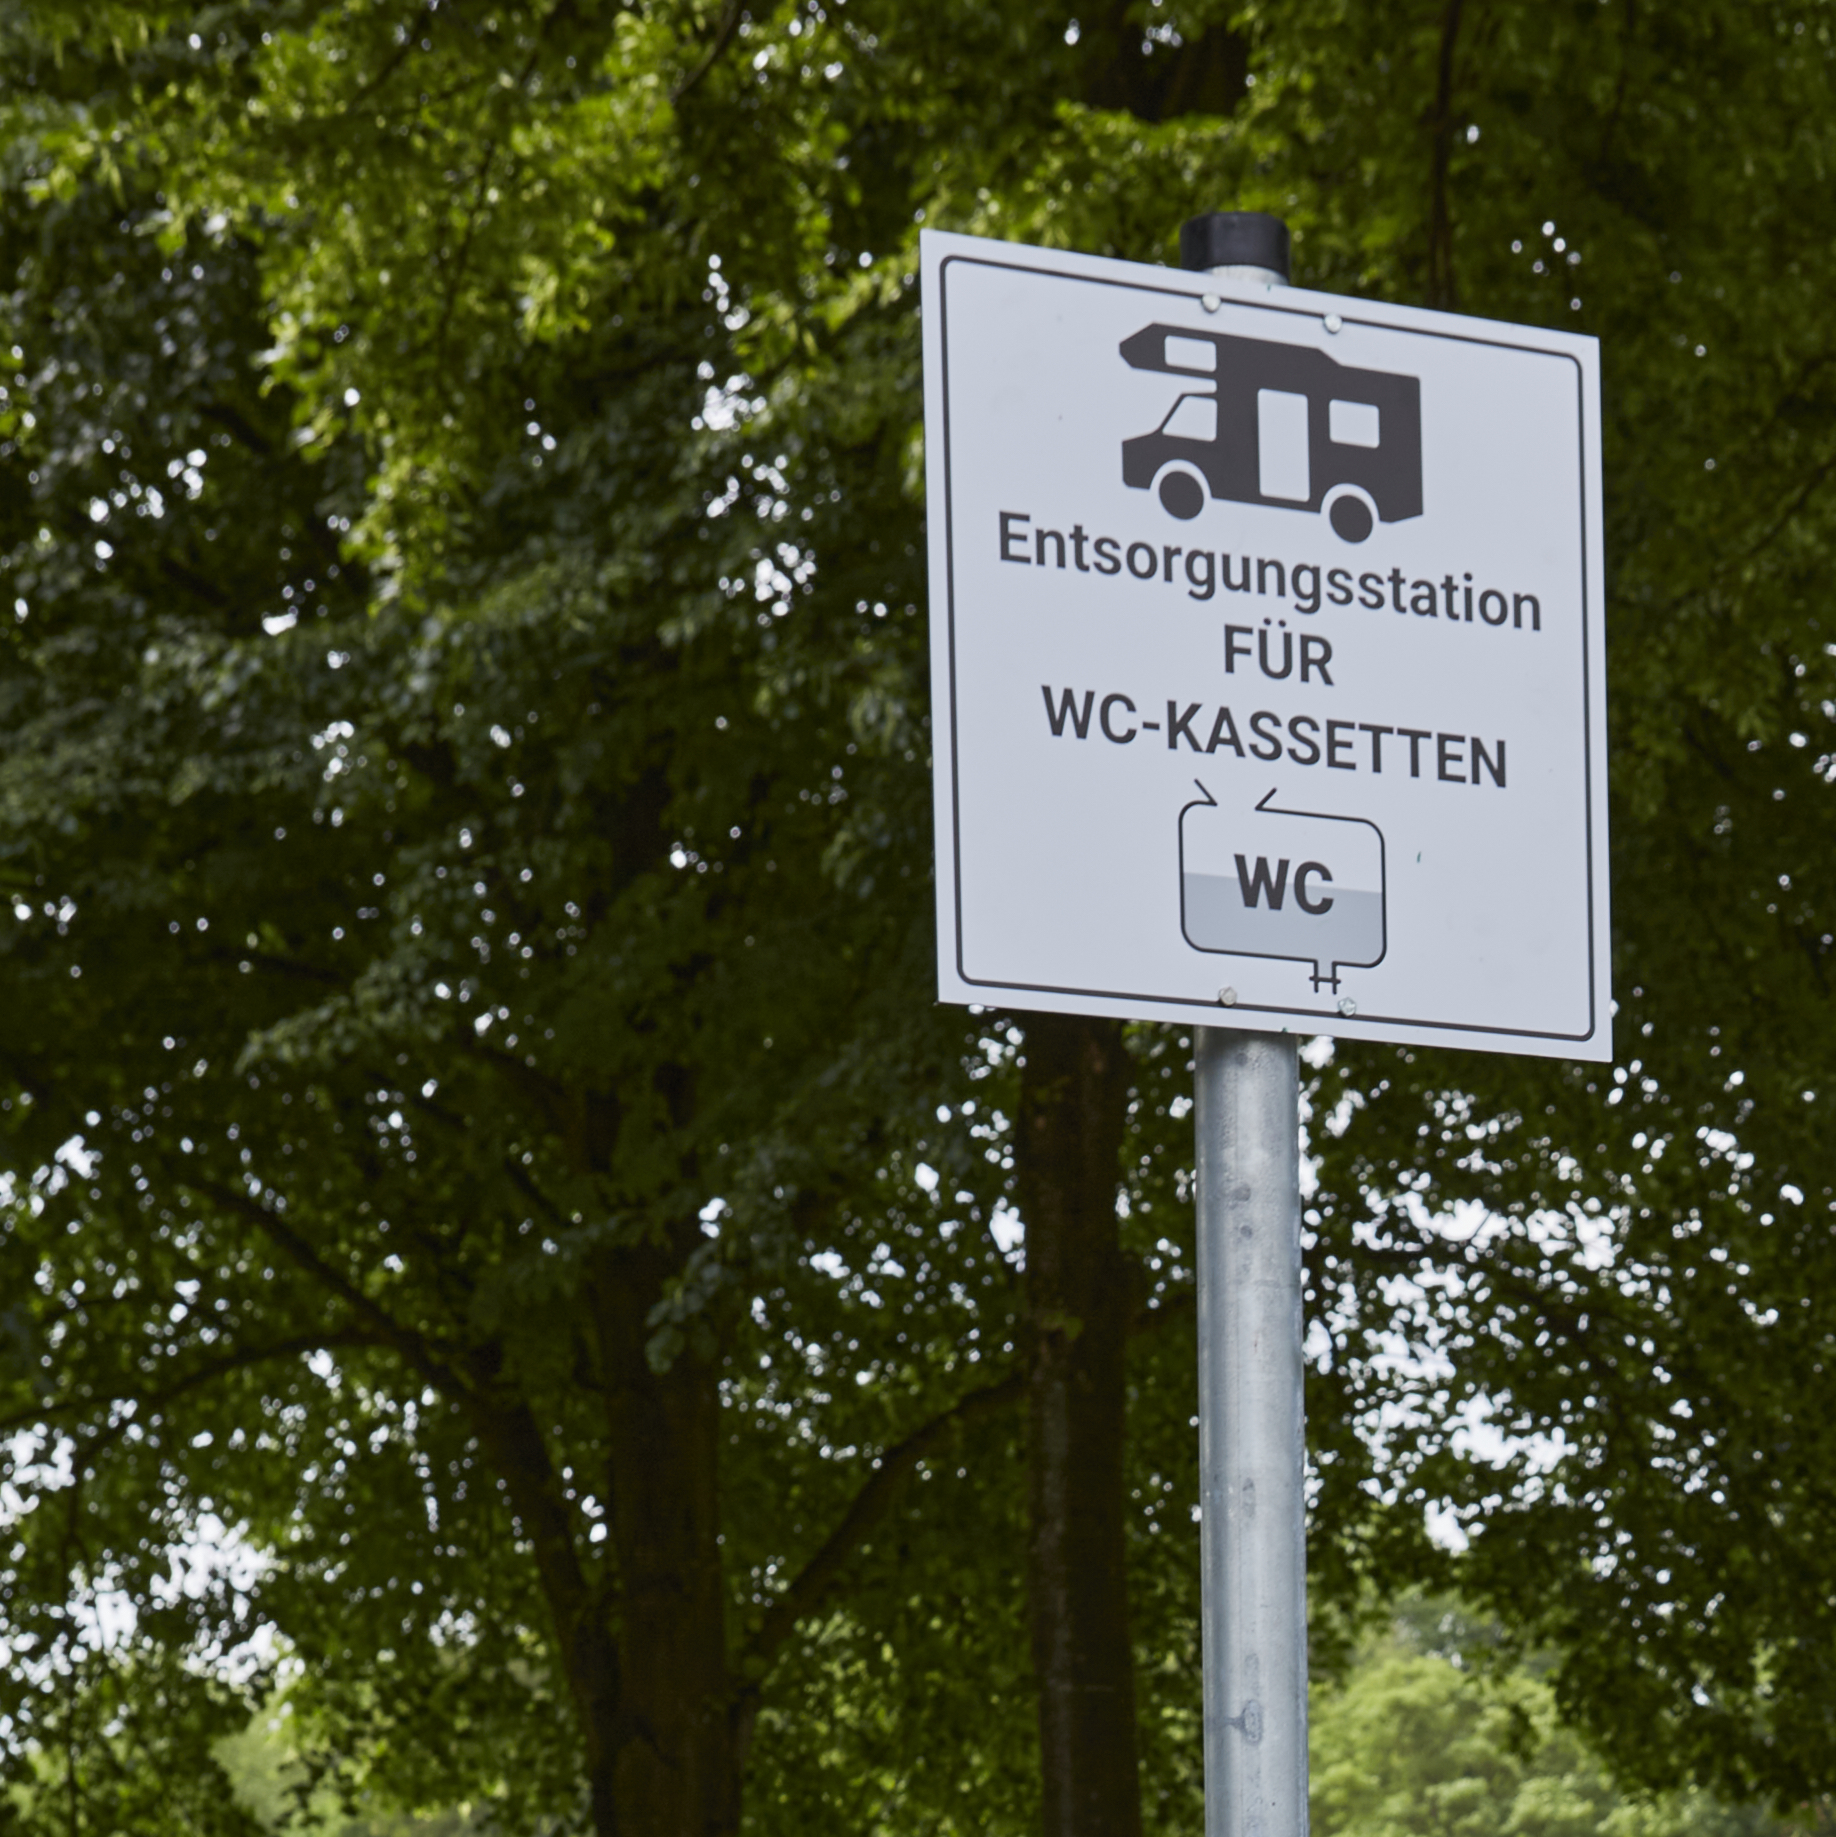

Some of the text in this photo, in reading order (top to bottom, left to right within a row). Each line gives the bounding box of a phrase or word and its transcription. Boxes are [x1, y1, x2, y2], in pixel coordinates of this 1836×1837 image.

[1000, 511, 1541, 632] Entsorgungsstation
[1223, 617, 1334, 686] FÜR
[1041, 684, 1507, 788] WC-KASSETTEN
[1234, 853, 1334, 915] WC
